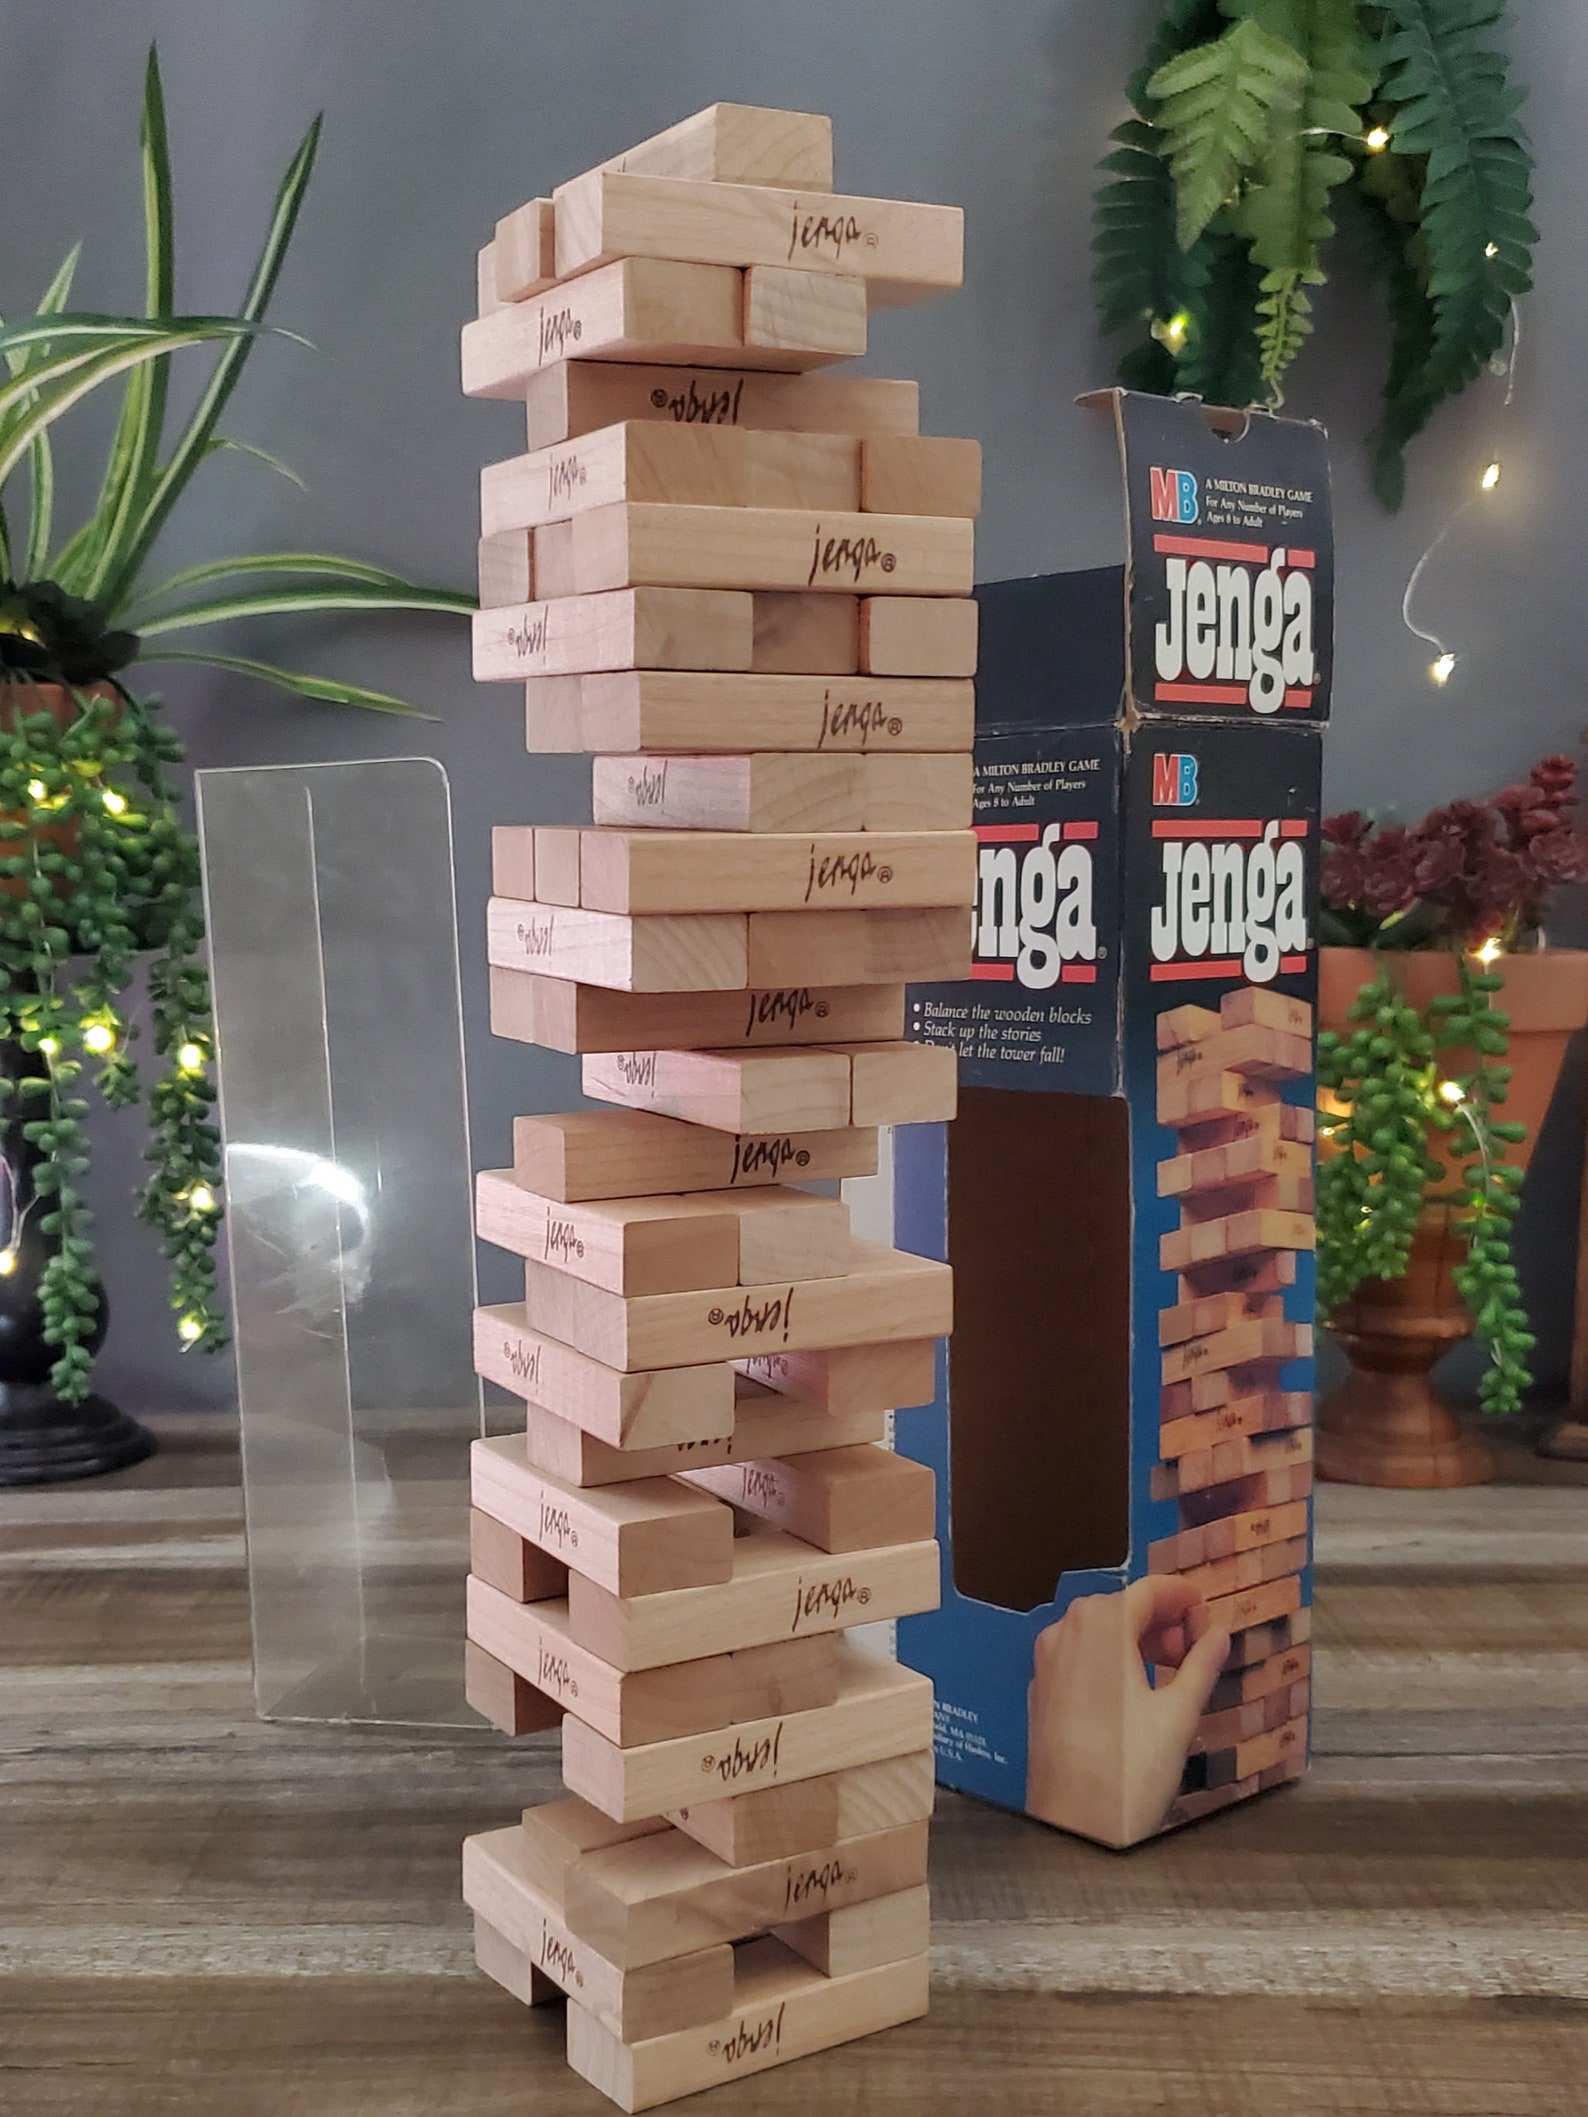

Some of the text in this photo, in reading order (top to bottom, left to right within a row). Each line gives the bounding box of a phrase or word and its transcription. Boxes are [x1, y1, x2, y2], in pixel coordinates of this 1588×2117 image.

[1150, 467, 1199, 525] MB
[1205, 479, 1313, 503] A MILTON BRADLEY GAME
[1205, 495, 1219, 508] For
[1220, 497, 1236, 512] Any
[1238, 499, 1267, 514] Number
[1155, 548, 1314, 714] Jenga
[983, 763, 1020, 777] MILTON
[1021, 761, 1066, 775] BRADLEY
[1068, 758, 1101, 772] GAME
[988, 782, 1005, 795] Any
[1007, 780, 1042, 793] Number
[1043, 779, 1053, 791] of
[1055, 778, 1086, 791] Players
[1153, 753, 1199, 806] MB
[971, 823, 1098, 989] nga
[1151, 820, 1307, 983] Jenga
[924, 1002, 1093, 1025] Balance the wooden blocks
[923, 1021, 1042, 1042] Stack up the stories
[959, 1043, 974, 1058] let
[977, 1044, 997, 1060] the
[1000, 1046, 1037, 1062] tower
[1039, 1046, 1065, 1065] fall!
